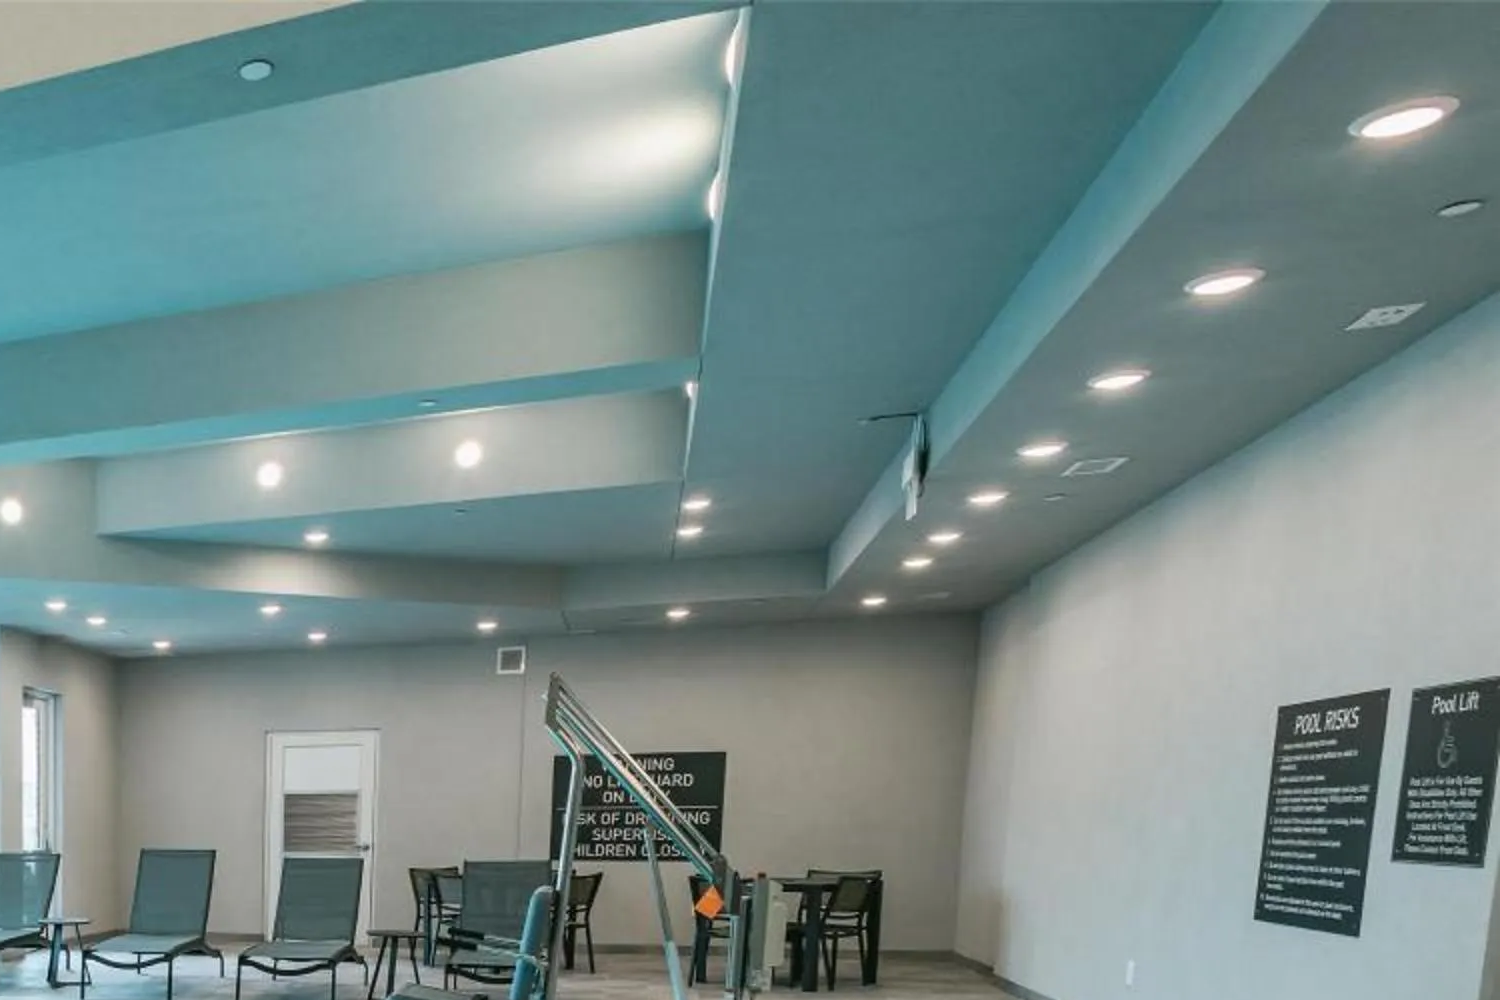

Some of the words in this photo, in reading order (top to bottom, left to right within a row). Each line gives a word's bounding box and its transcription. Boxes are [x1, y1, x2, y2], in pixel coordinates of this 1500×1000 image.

[1431, 695, 1457, 715] Pool
[1459, 691, 1480, 712] Lift
[1294, 714, 1321, 735] POOL
[1324, 706, 1361, 732] RISKS
[603, 791, 624, 804] ON
[601, 811, 621, 825] OF
[570, 843, 637, 857] HILDREN
